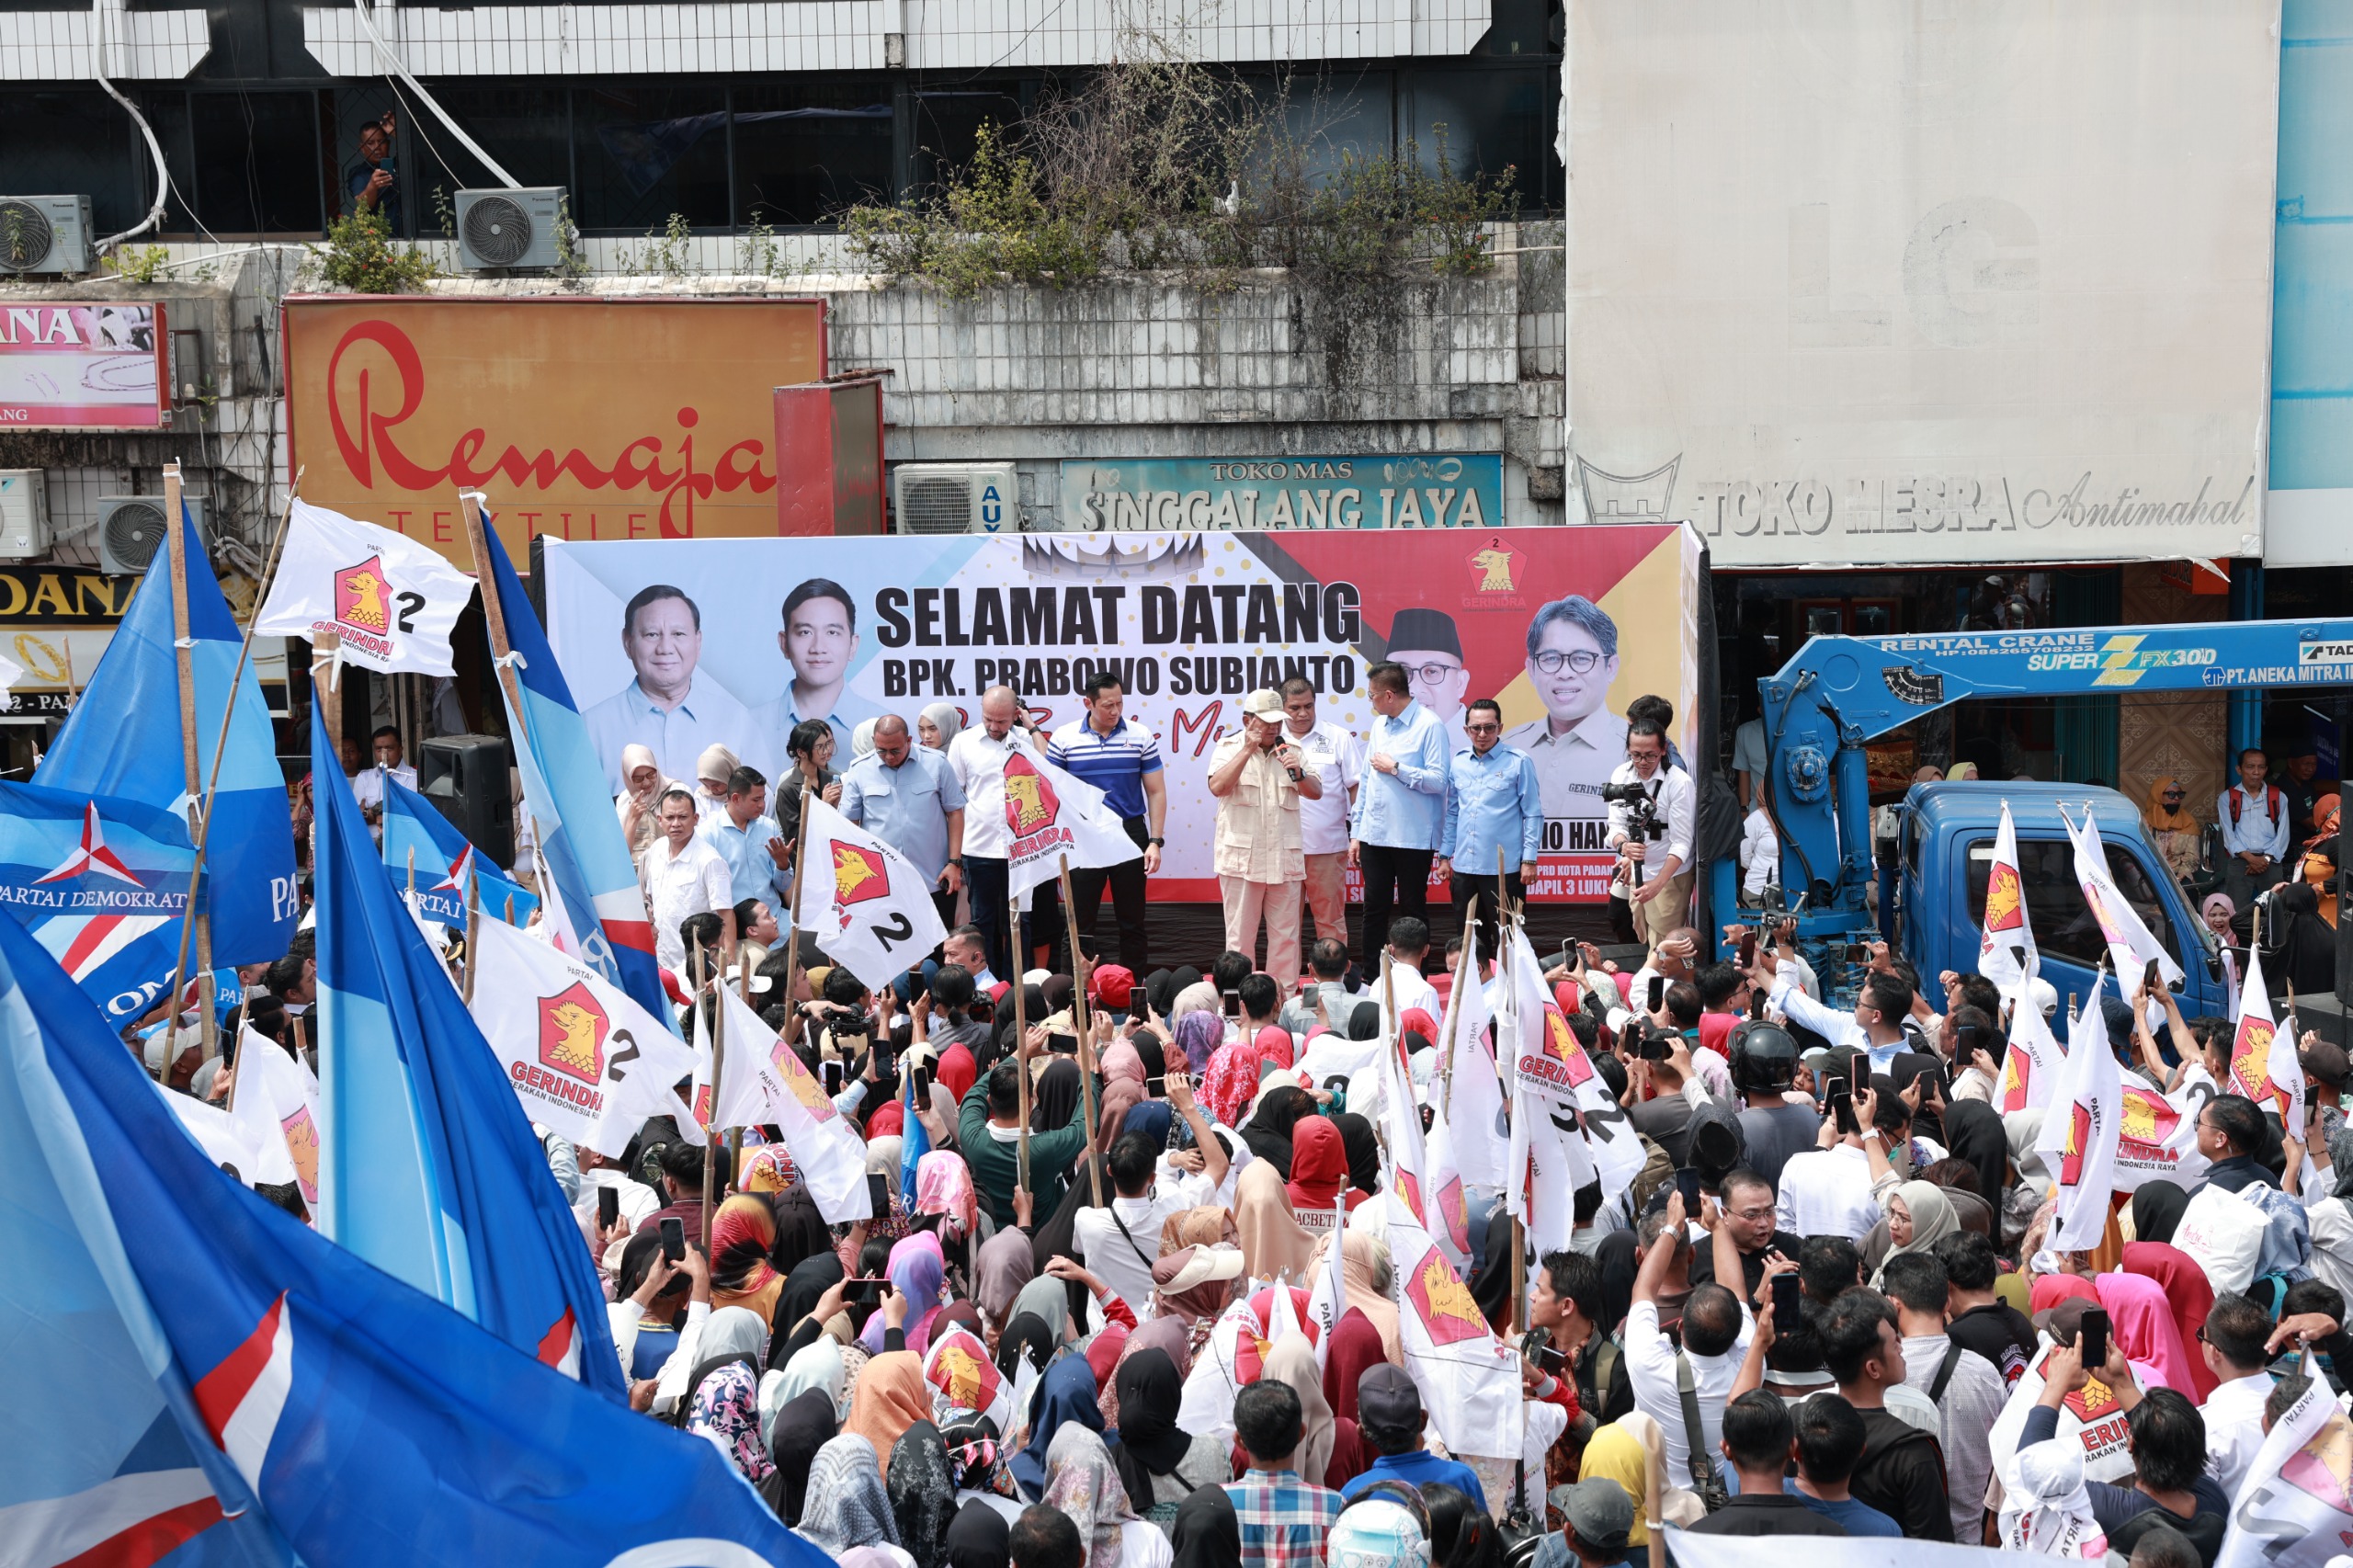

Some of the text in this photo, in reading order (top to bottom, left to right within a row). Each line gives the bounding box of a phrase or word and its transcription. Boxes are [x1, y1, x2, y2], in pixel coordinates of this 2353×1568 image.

[0, 308, 83, 345] NA
[327, 320, 778, 539] Remaja
[1210, 461, 1353, 481] TOKO MAS
[1078, 486, 1364, 532] SINGGALANG
[1697, 470, 2255, 537] TOKO MESRA Antimahal
[388, 511, 647, 542] TETILE
[1492, 539, 1499, 548] 2
[396, 591, 426, 634] 2
[875, 582, 1361, 649] SELAMAT DATANG
[312, 620, 395, 656] GERINDR
[341, 640, 379, 660] INDONESIA
[1881, 633, 2095, 653] RENTAL CRANE
[882, 654, 1356, 697] BPK. PRABOWO SUBIANTO
[2027, 653, 2099, 672] SUPER
[2298, 665, 2343, 682] MITRA
[870, 841, 898, 862] PARTAI
[1558, 865, 1582, 877] KOTA
[2087, 871, 2109, 892] PARTAI
[70, 890, 188, 909] DEMOKRAT
[1565, 879, 1575, 896] 3
[870, 912, 914, 954] 2
[567, 966, 593, 981] PARTAI
[608, 1028, 641, 1083] 2
[2027, 1040, 2043, 1069] PARTAI
[758, 1070, 780, 1098] PARTAI
[1515, 1070, 1549, 1088] GERAKAN
[2290, 1078, 2303, 1106] PARTAI
[548, 1094, 591, 1119] INDONESIA
[1584, 1088, 1625, 1144] 2
[2117, 1159, 2177, 1173] INDONESIA RAYA
